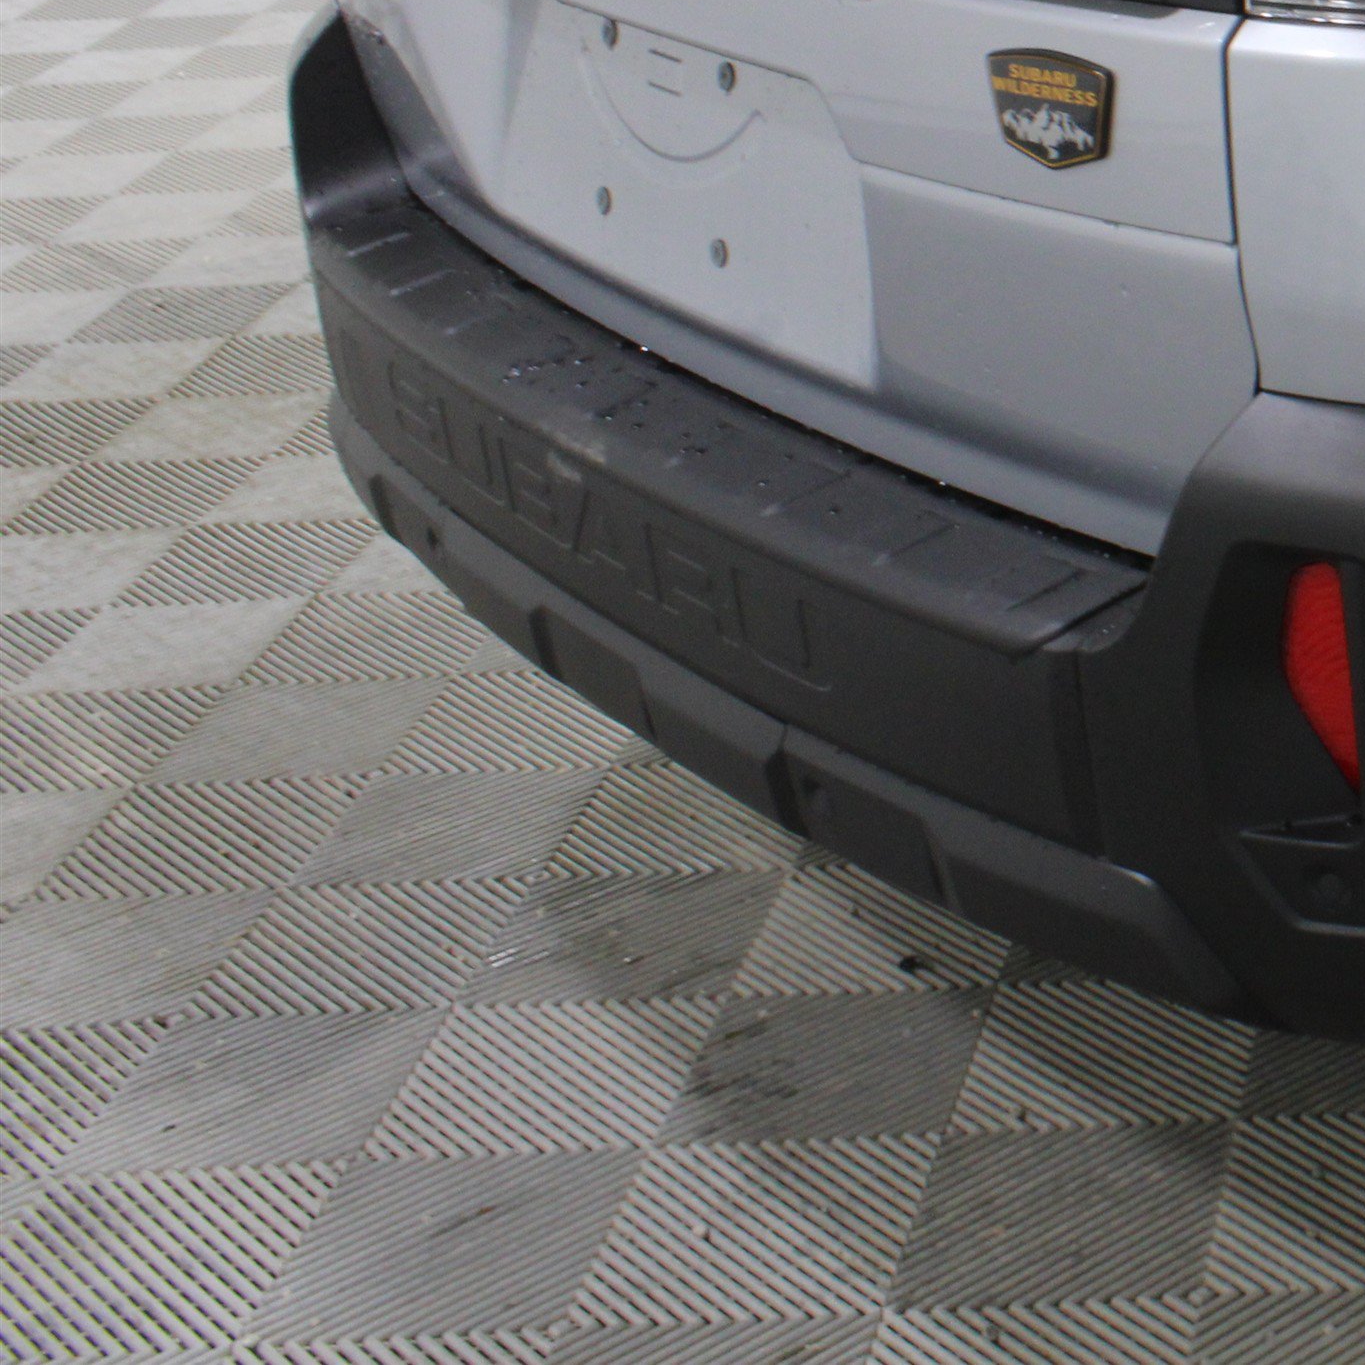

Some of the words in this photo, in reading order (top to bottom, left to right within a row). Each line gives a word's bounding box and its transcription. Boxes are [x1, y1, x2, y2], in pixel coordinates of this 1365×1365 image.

[990, 75, 1099, 108] WILDERNESS
[1007, 62, 1078, 88] SUBARU
[385, 357, 835, 691] SUBARU
